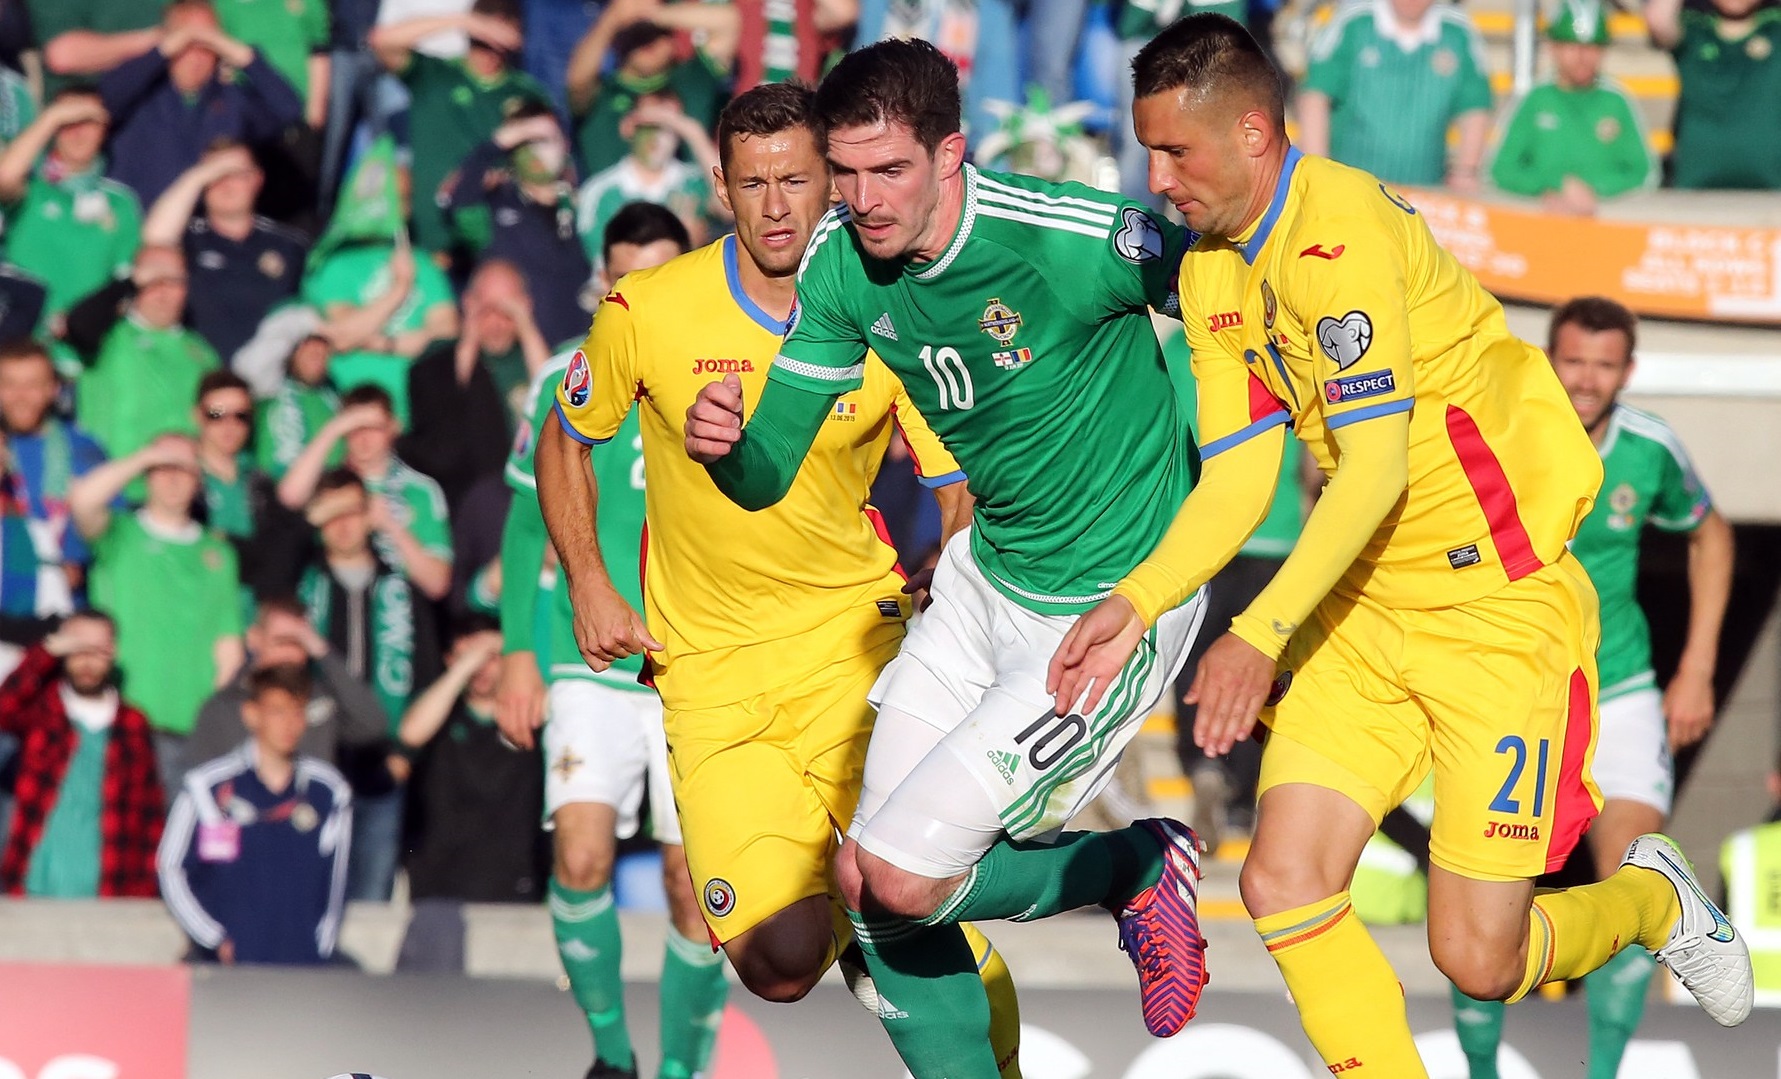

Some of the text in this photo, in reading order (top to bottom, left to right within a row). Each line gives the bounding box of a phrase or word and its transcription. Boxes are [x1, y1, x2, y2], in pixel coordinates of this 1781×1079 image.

[870, 325, 899, 342] adidas
[918, 345, 975, 411] 10
[1341, 375, 1393, 396] RESPECT
[1013, 705, 1087, 771] 10
[986, 749, 1015, 787] adidas
[1488, 735, 1549, 817] 21
[1483, 821, 1540, 841] Joma
[1327, 1056, 1363, 1074] ma
